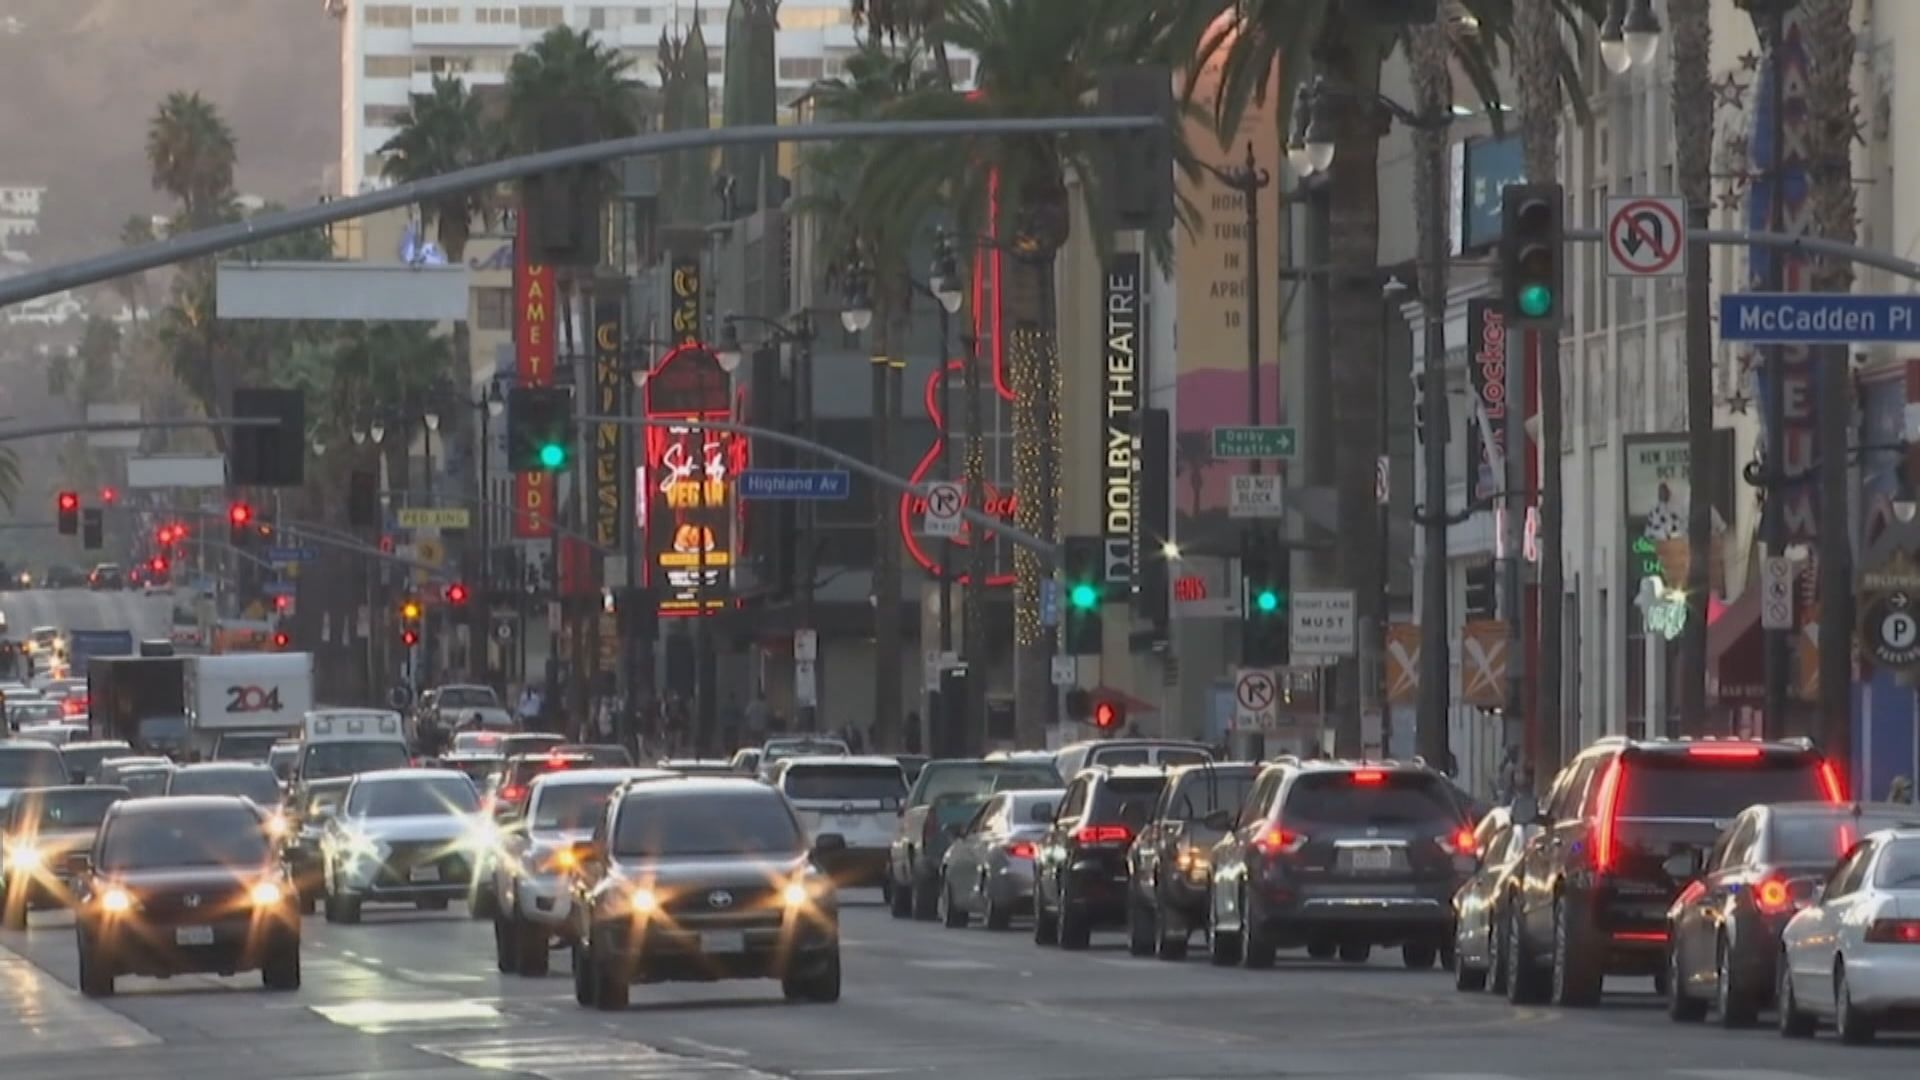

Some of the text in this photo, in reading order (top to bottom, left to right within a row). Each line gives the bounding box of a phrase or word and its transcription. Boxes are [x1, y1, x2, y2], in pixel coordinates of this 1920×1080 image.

[1211, 193, 1245, 211] HOM
[1223, 254, 1239, 269] IN
[1210, 280, 1249, 299] APRI
[1225, 311, 1240, 328] 10
[1740, 305, 1912, 332] McCadden Pl
[1476, 309, 1504, 418] Locker
[1108, 274, 1134, 533] DOLBY THEATRE
[749, 477, 839, 496] Highland Av
[1301, 616, 1344, 628] MUST
[1894, 619, 1908, 642] P
[226, 686, 284, 712] 204
